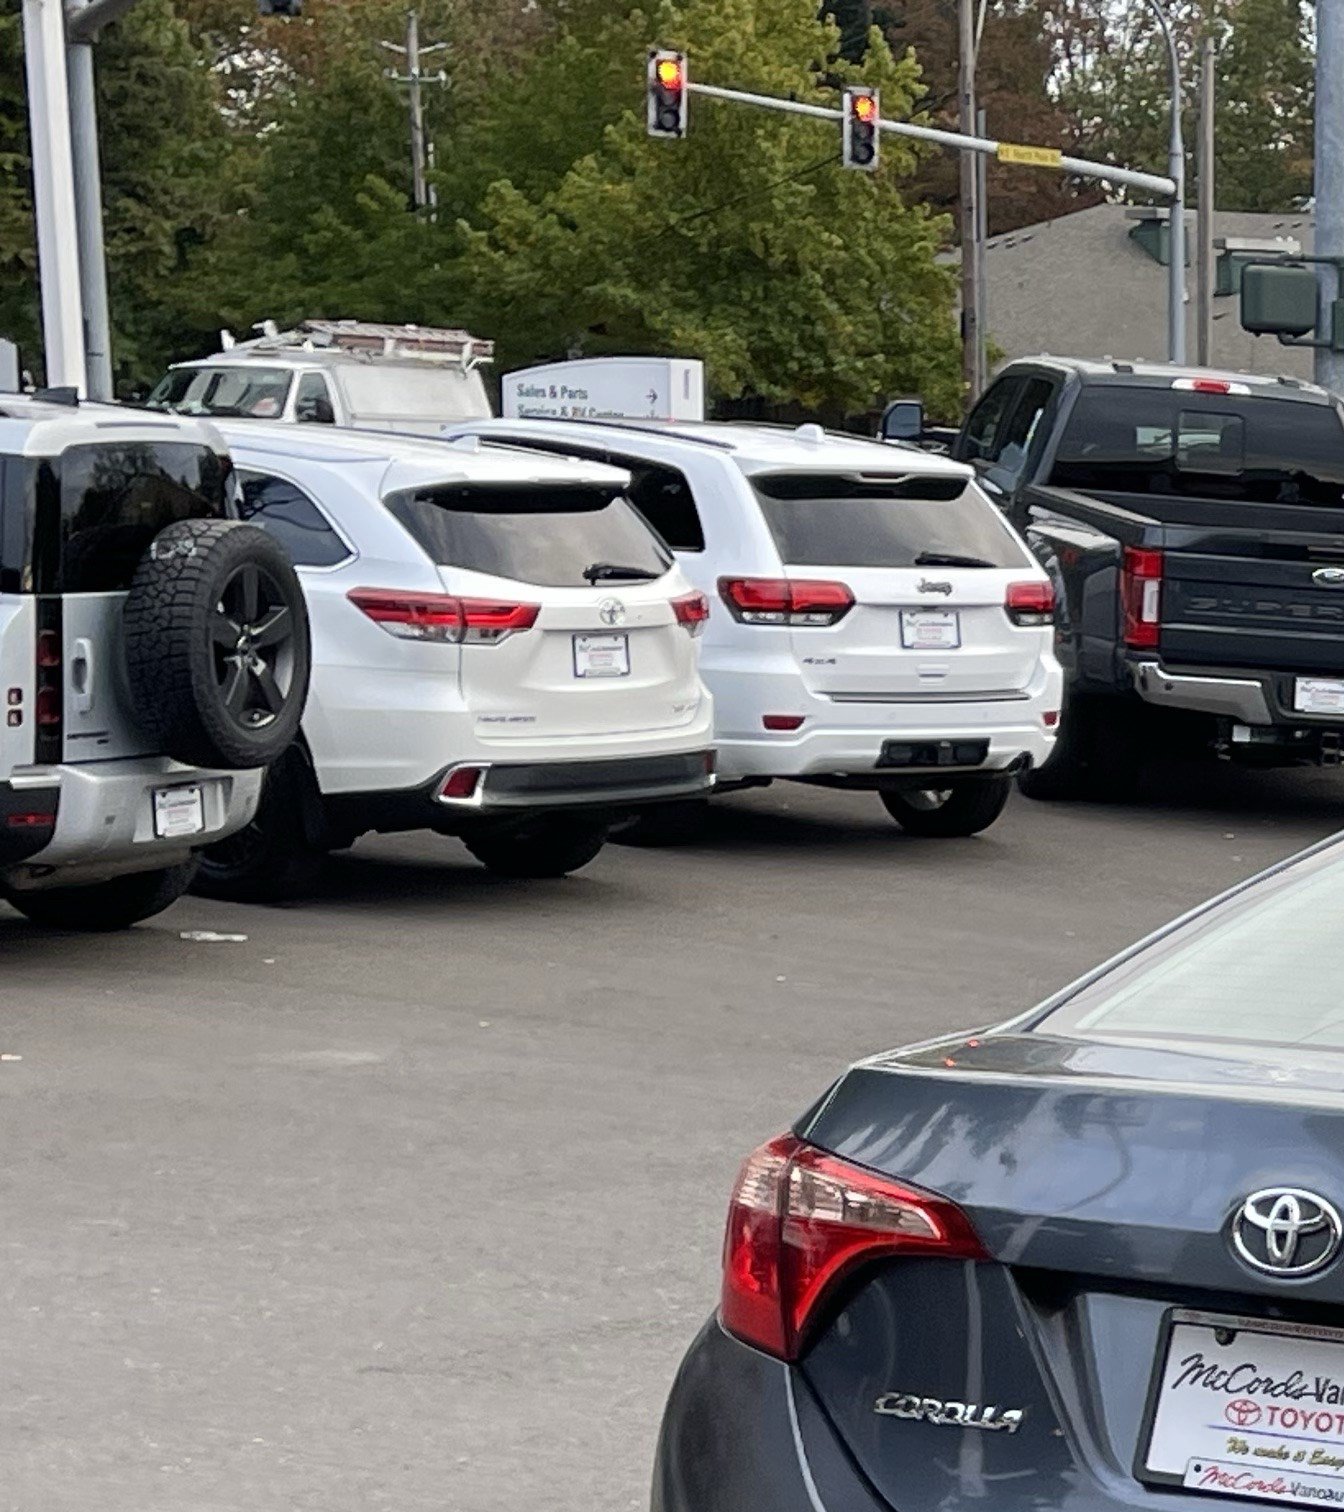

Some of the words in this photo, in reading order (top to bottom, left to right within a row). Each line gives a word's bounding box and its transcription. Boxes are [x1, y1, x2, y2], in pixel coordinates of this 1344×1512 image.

[516, 383, 546, 399] Sales
[560, 385, 588, 400] Parts
[1188, 597, 1344, 620] SUPER
[873, 1392, 1023, 1434] COROLLA
